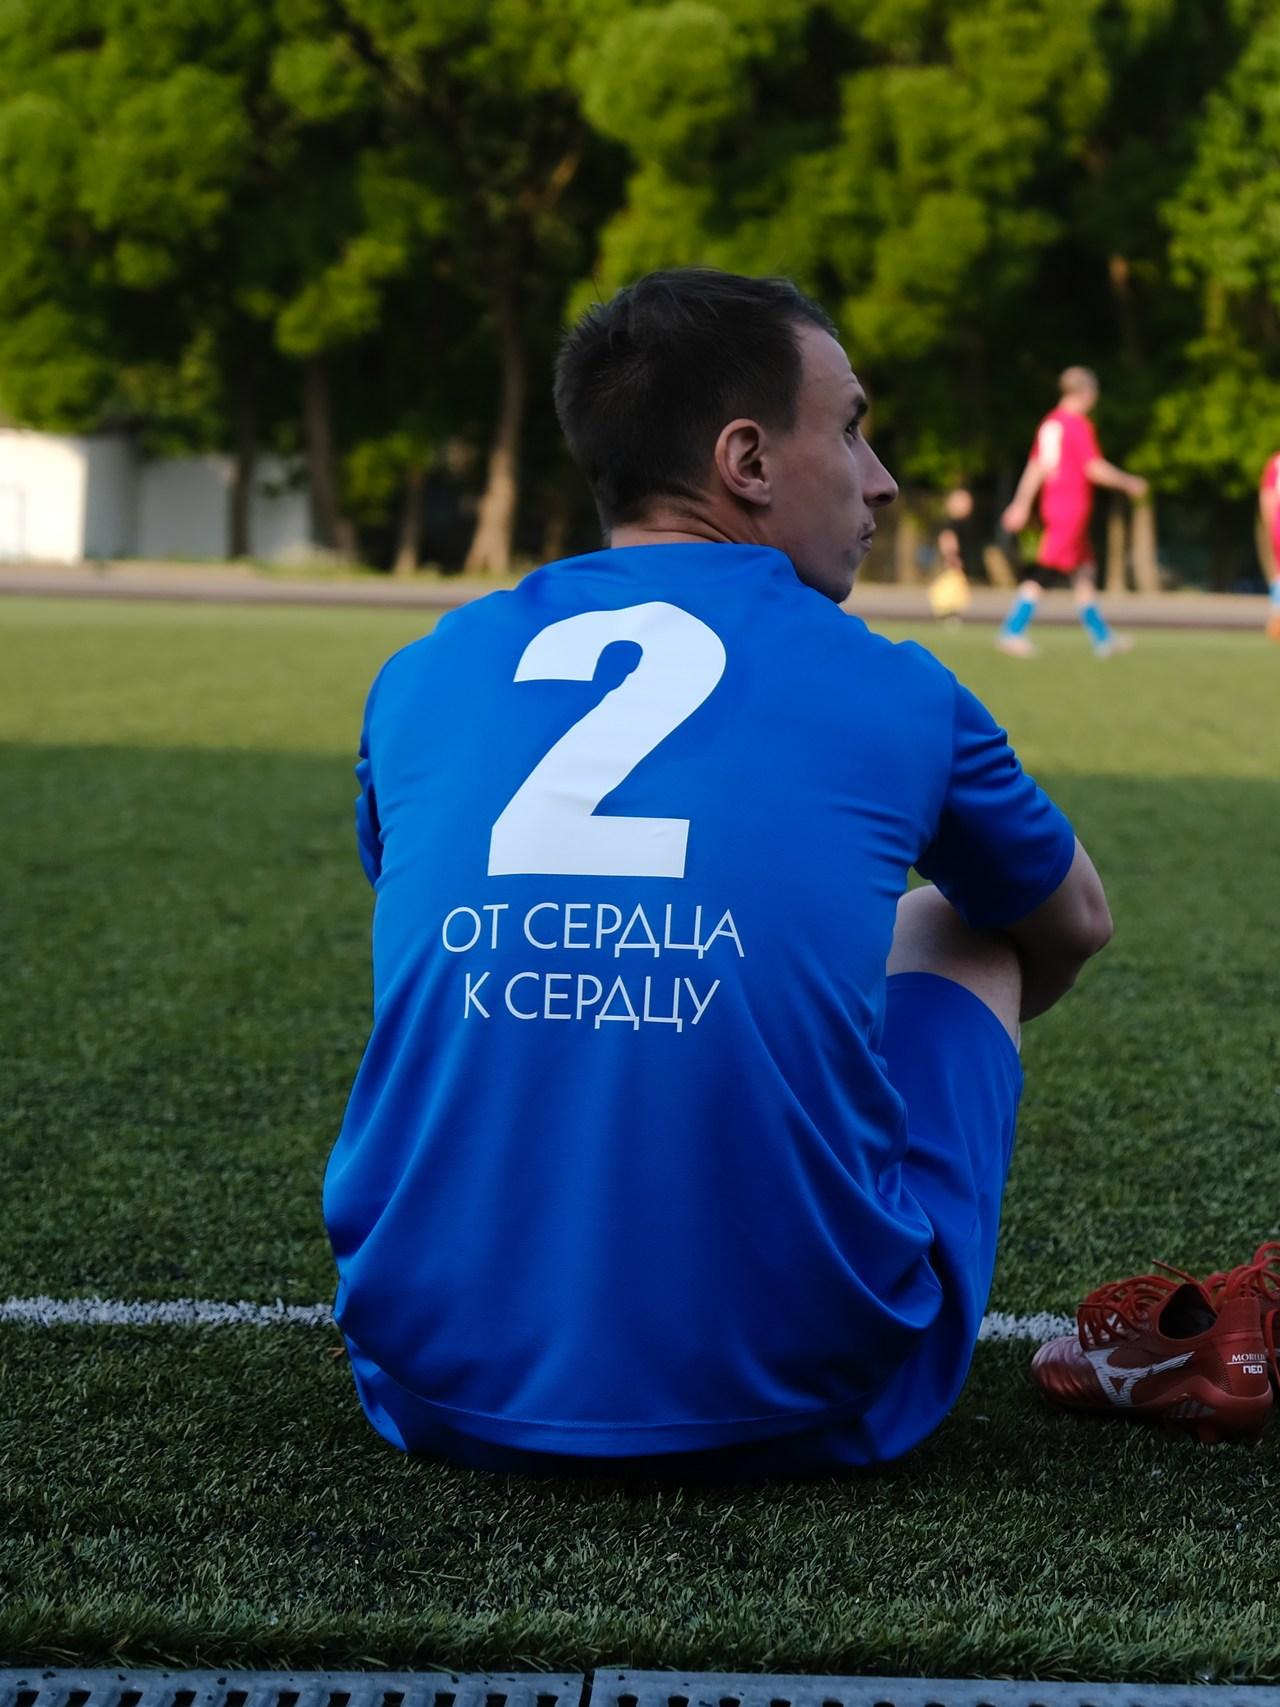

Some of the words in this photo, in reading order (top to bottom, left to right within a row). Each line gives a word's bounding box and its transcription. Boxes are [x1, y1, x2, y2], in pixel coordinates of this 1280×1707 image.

[487, 601, 727, 879] 2
[442, 902, 509, 954] ОТ
[523, 902, 745, 960] СЕРДЦА
[464, 970, 491, 1019] К
[504, 970, 721, 1033] СЕРДЦУ
